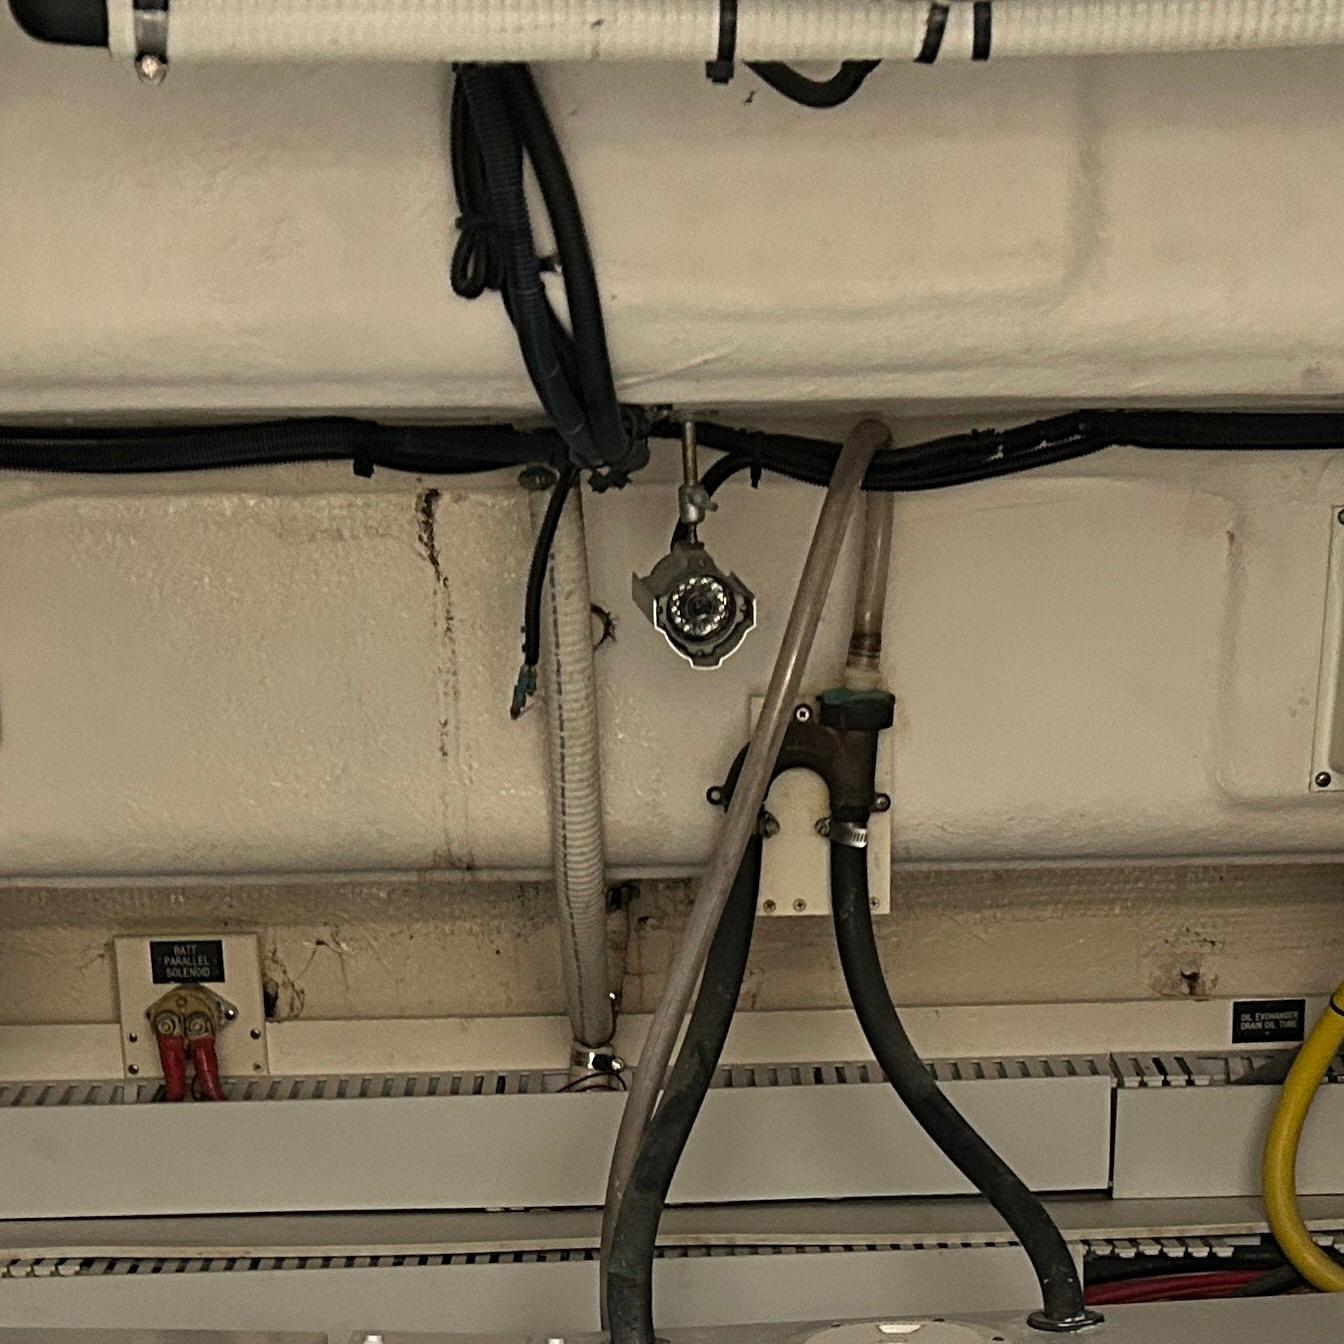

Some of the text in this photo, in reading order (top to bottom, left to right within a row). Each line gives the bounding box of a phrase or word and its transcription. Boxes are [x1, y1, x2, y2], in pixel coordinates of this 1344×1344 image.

[174, 944, 197, 956] BATT
[164, 955, 210, 967] PARALLEL
[166, 967, 211, 978] SOLENOID
